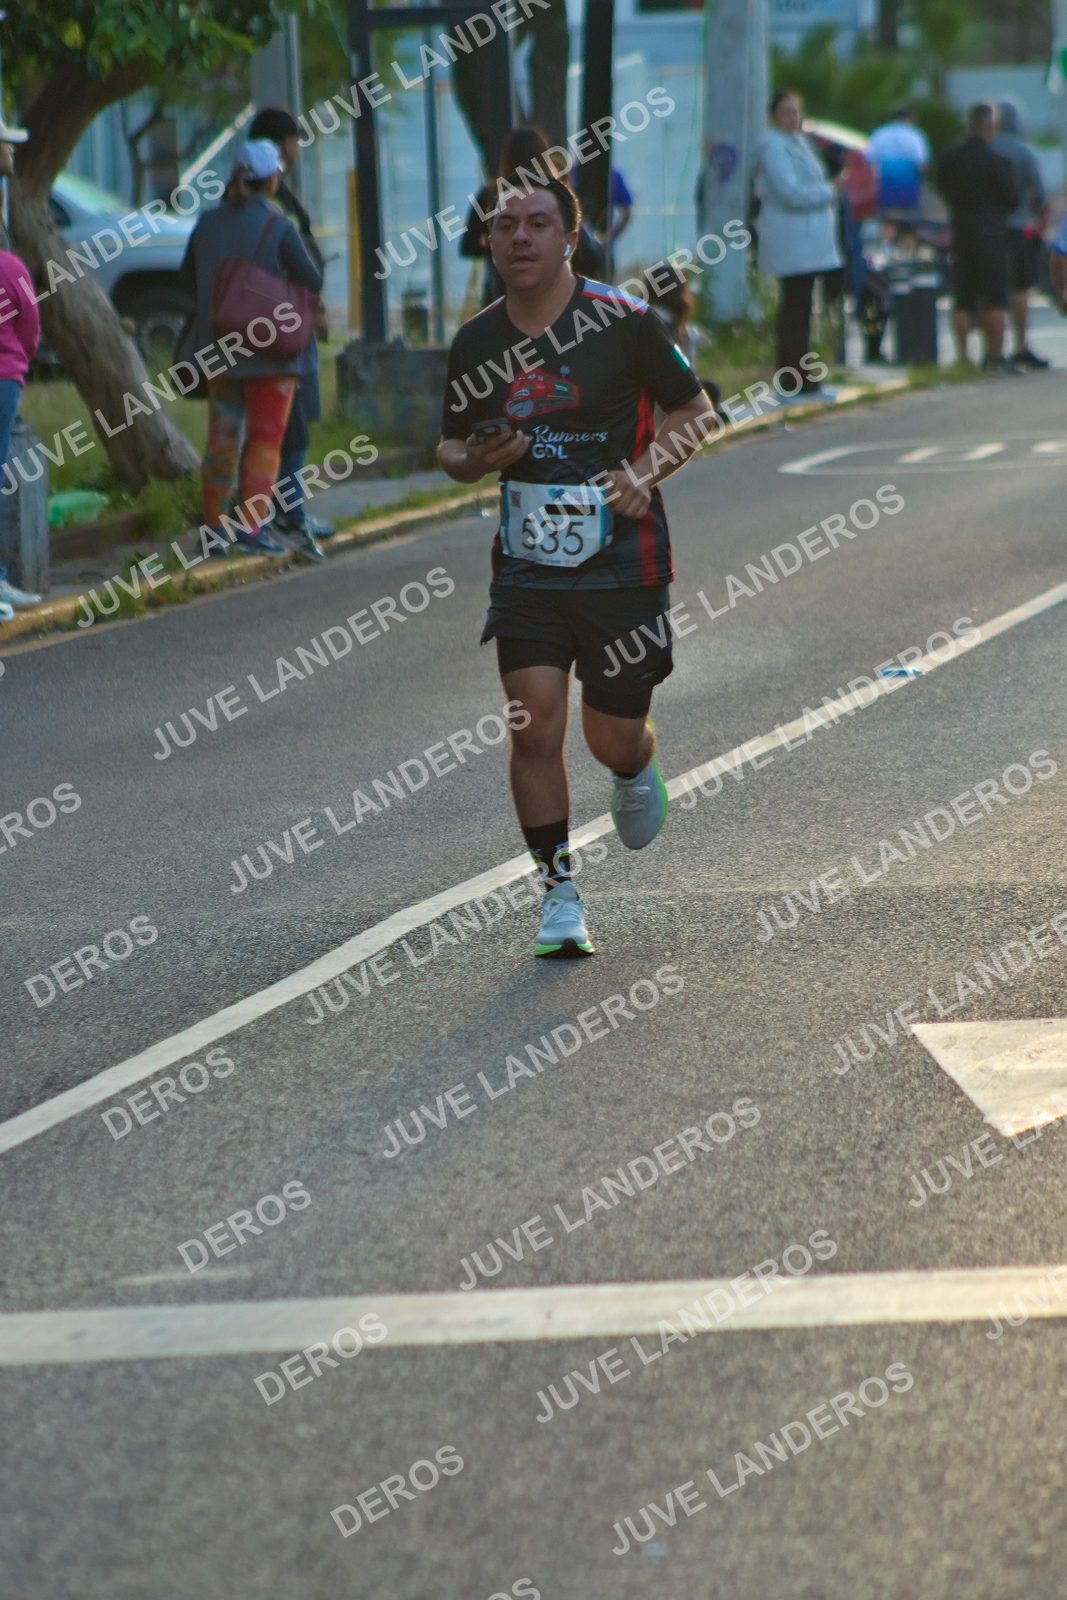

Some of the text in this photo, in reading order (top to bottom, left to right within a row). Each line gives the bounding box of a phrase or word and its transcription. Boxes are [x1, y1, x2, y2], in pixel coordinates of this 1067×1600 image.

[531, 424, 609, 443] Runners
[531, 443, 568, 460] GDL
[521, 518, 584, 556] 535
